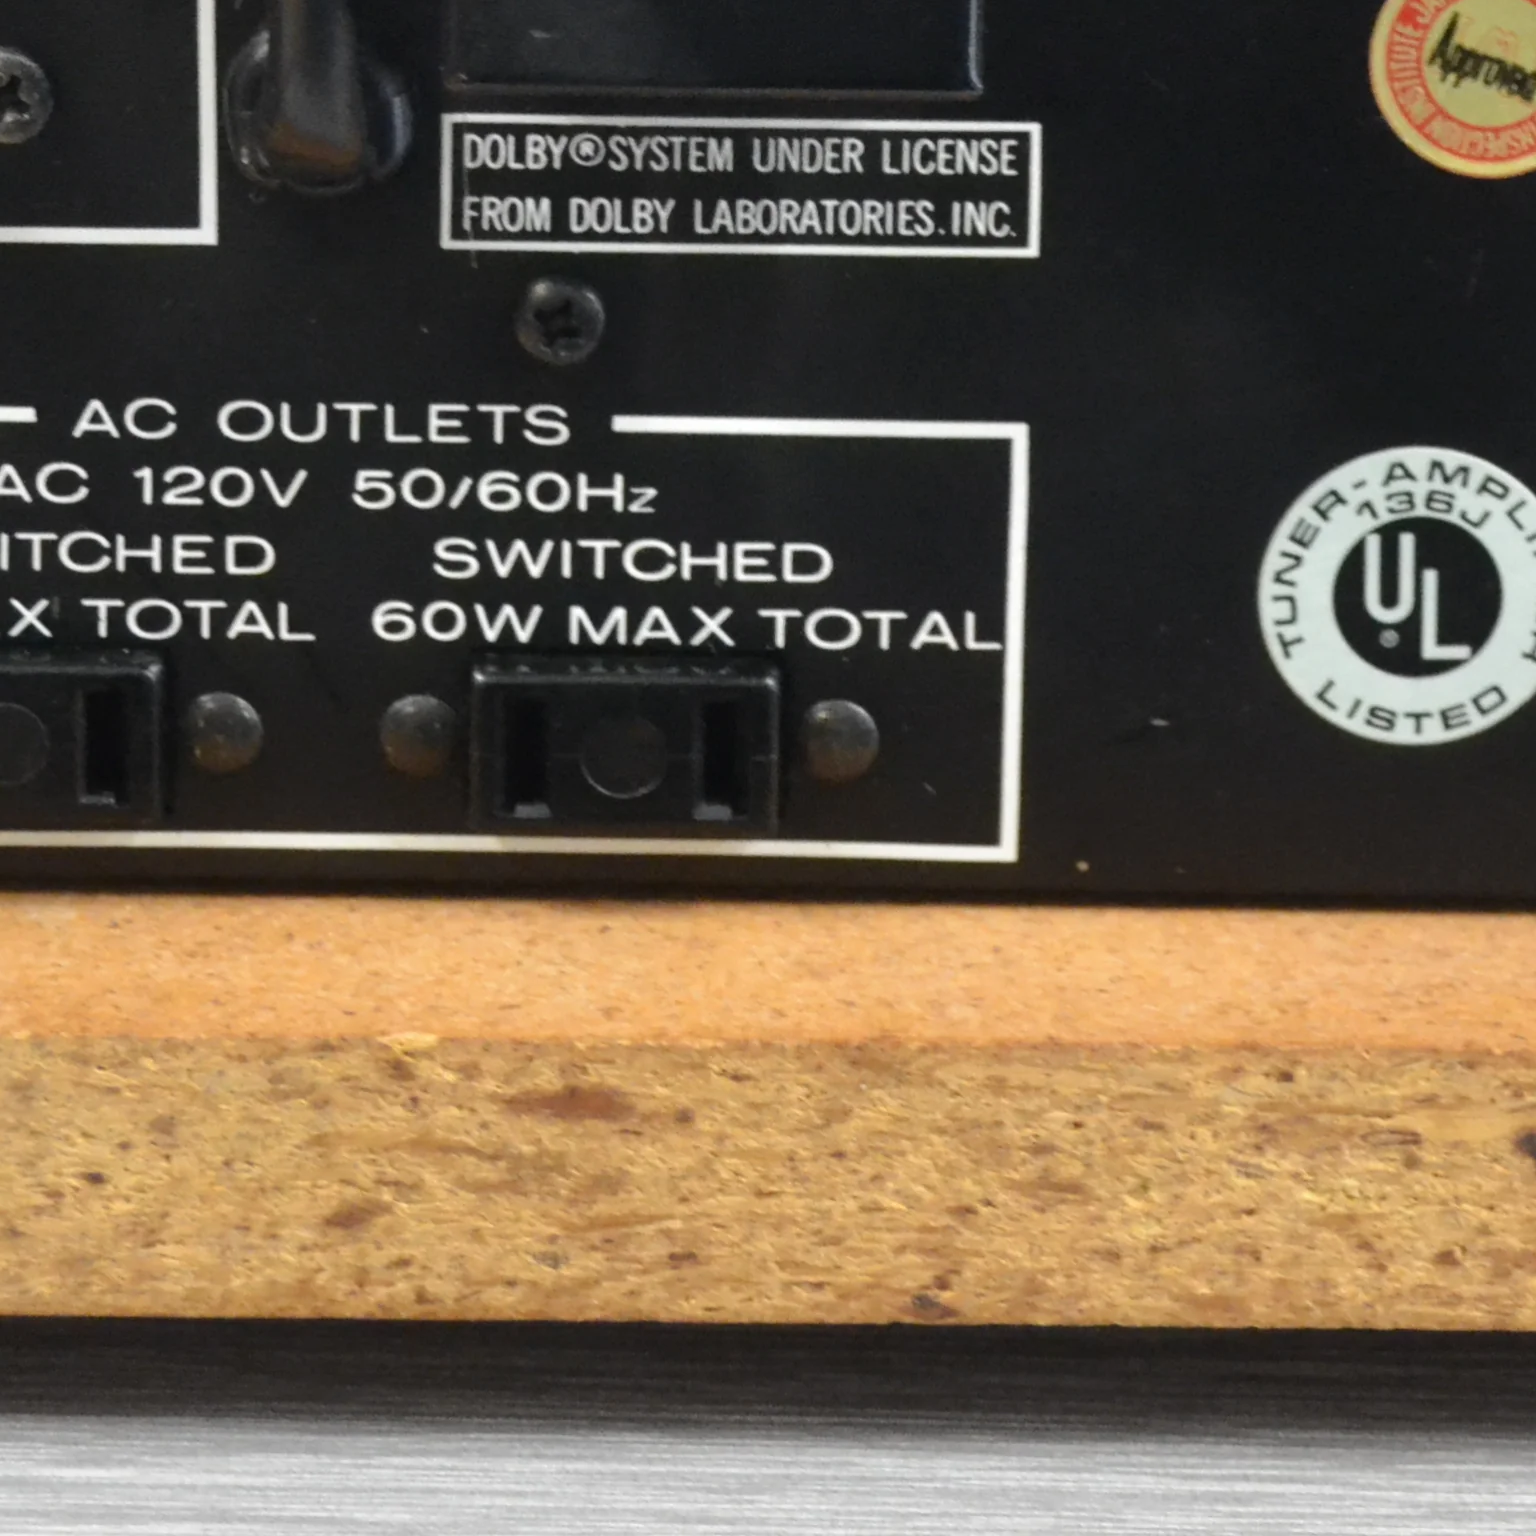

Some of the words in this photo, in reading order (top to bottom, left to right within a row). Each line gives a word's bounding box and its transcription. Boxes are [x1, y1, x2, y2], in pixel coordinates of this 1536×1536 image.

[752, 137, 865, 174] UNDER
[882, 138, 1018, 176] LICENSE
[462, 195, 552, 233] FROM
[569, 196, 676, 234] DOLBY
[71, 397, 177, 440] AC
[217, 399, 571, 446] OUTLETS
[133, 465, 308, 508] 120V
[351, 467, 658, 513] 50/60Hz
[1355, 490, 1491, 530] 136J
[433, 537, 834, 583] SWITCHED
[80, 598, 316, 641] TOTAL
[1365, 531, 1473, 661] UL
[371, 600, 543, 644] 60W
[569, 605, 735, 647] MAX
[757, 607, 1003, 651] TOTAL
[1316, 679, 1507, 735] LISTED
